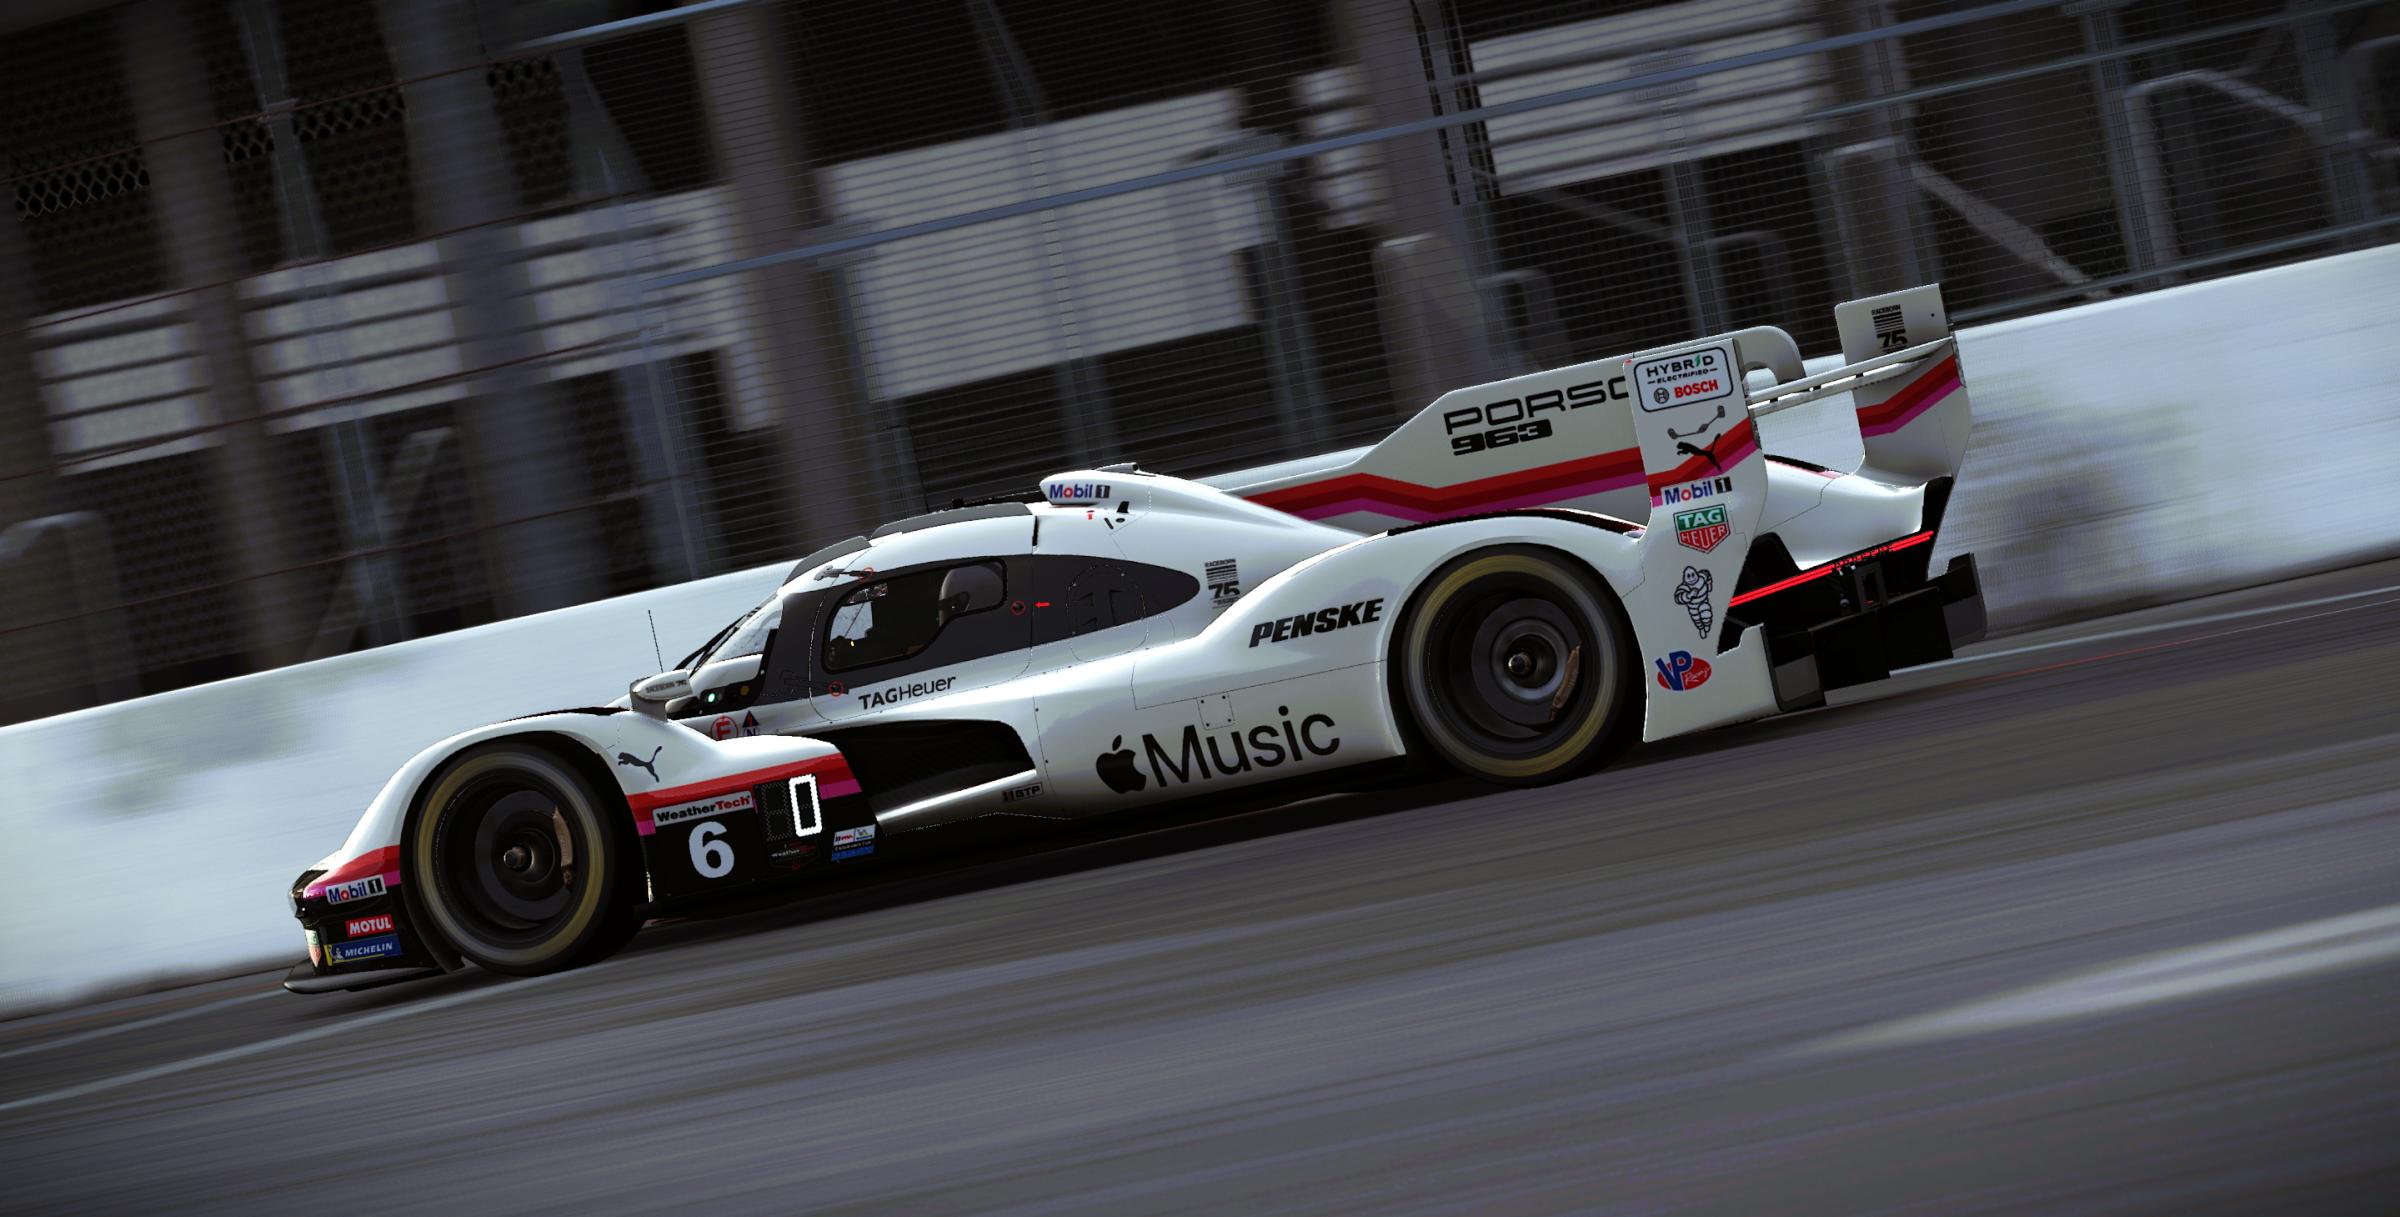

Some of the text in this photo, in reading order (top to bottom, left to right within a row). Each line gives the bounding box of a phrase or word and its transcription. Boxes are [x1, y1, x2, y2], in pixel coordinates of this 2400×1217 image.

[1876, 329, 1908, 348] 75
[1657, 369, 1709, 384] ELECTRIFIED
[1674, 379, 1719, 399] BOSCH
[1451, 419, 1553, 456] 963
[1049, 483, 1093, 499] Mobil
[1664, 480, 1713, 505] Mobil
[1679, 508, 1722, 528] TAG
[1680, 525, 1727, 549] HEUER
[1208, 580, 1240, 599] 75
[1249, 598, 1384, 648] PENSKE
[1655, 650, 1692, 691] VP
[1142, 705, 1340, 788] Music
[657, 796, 751, 821] WeatherTech
[689, 821, 735, 879] 6
[327, 881, 368, 903] Mobil
[349, 917, 392, 936] MOTUL
[345, 942, 393, 958] MICHELIN
